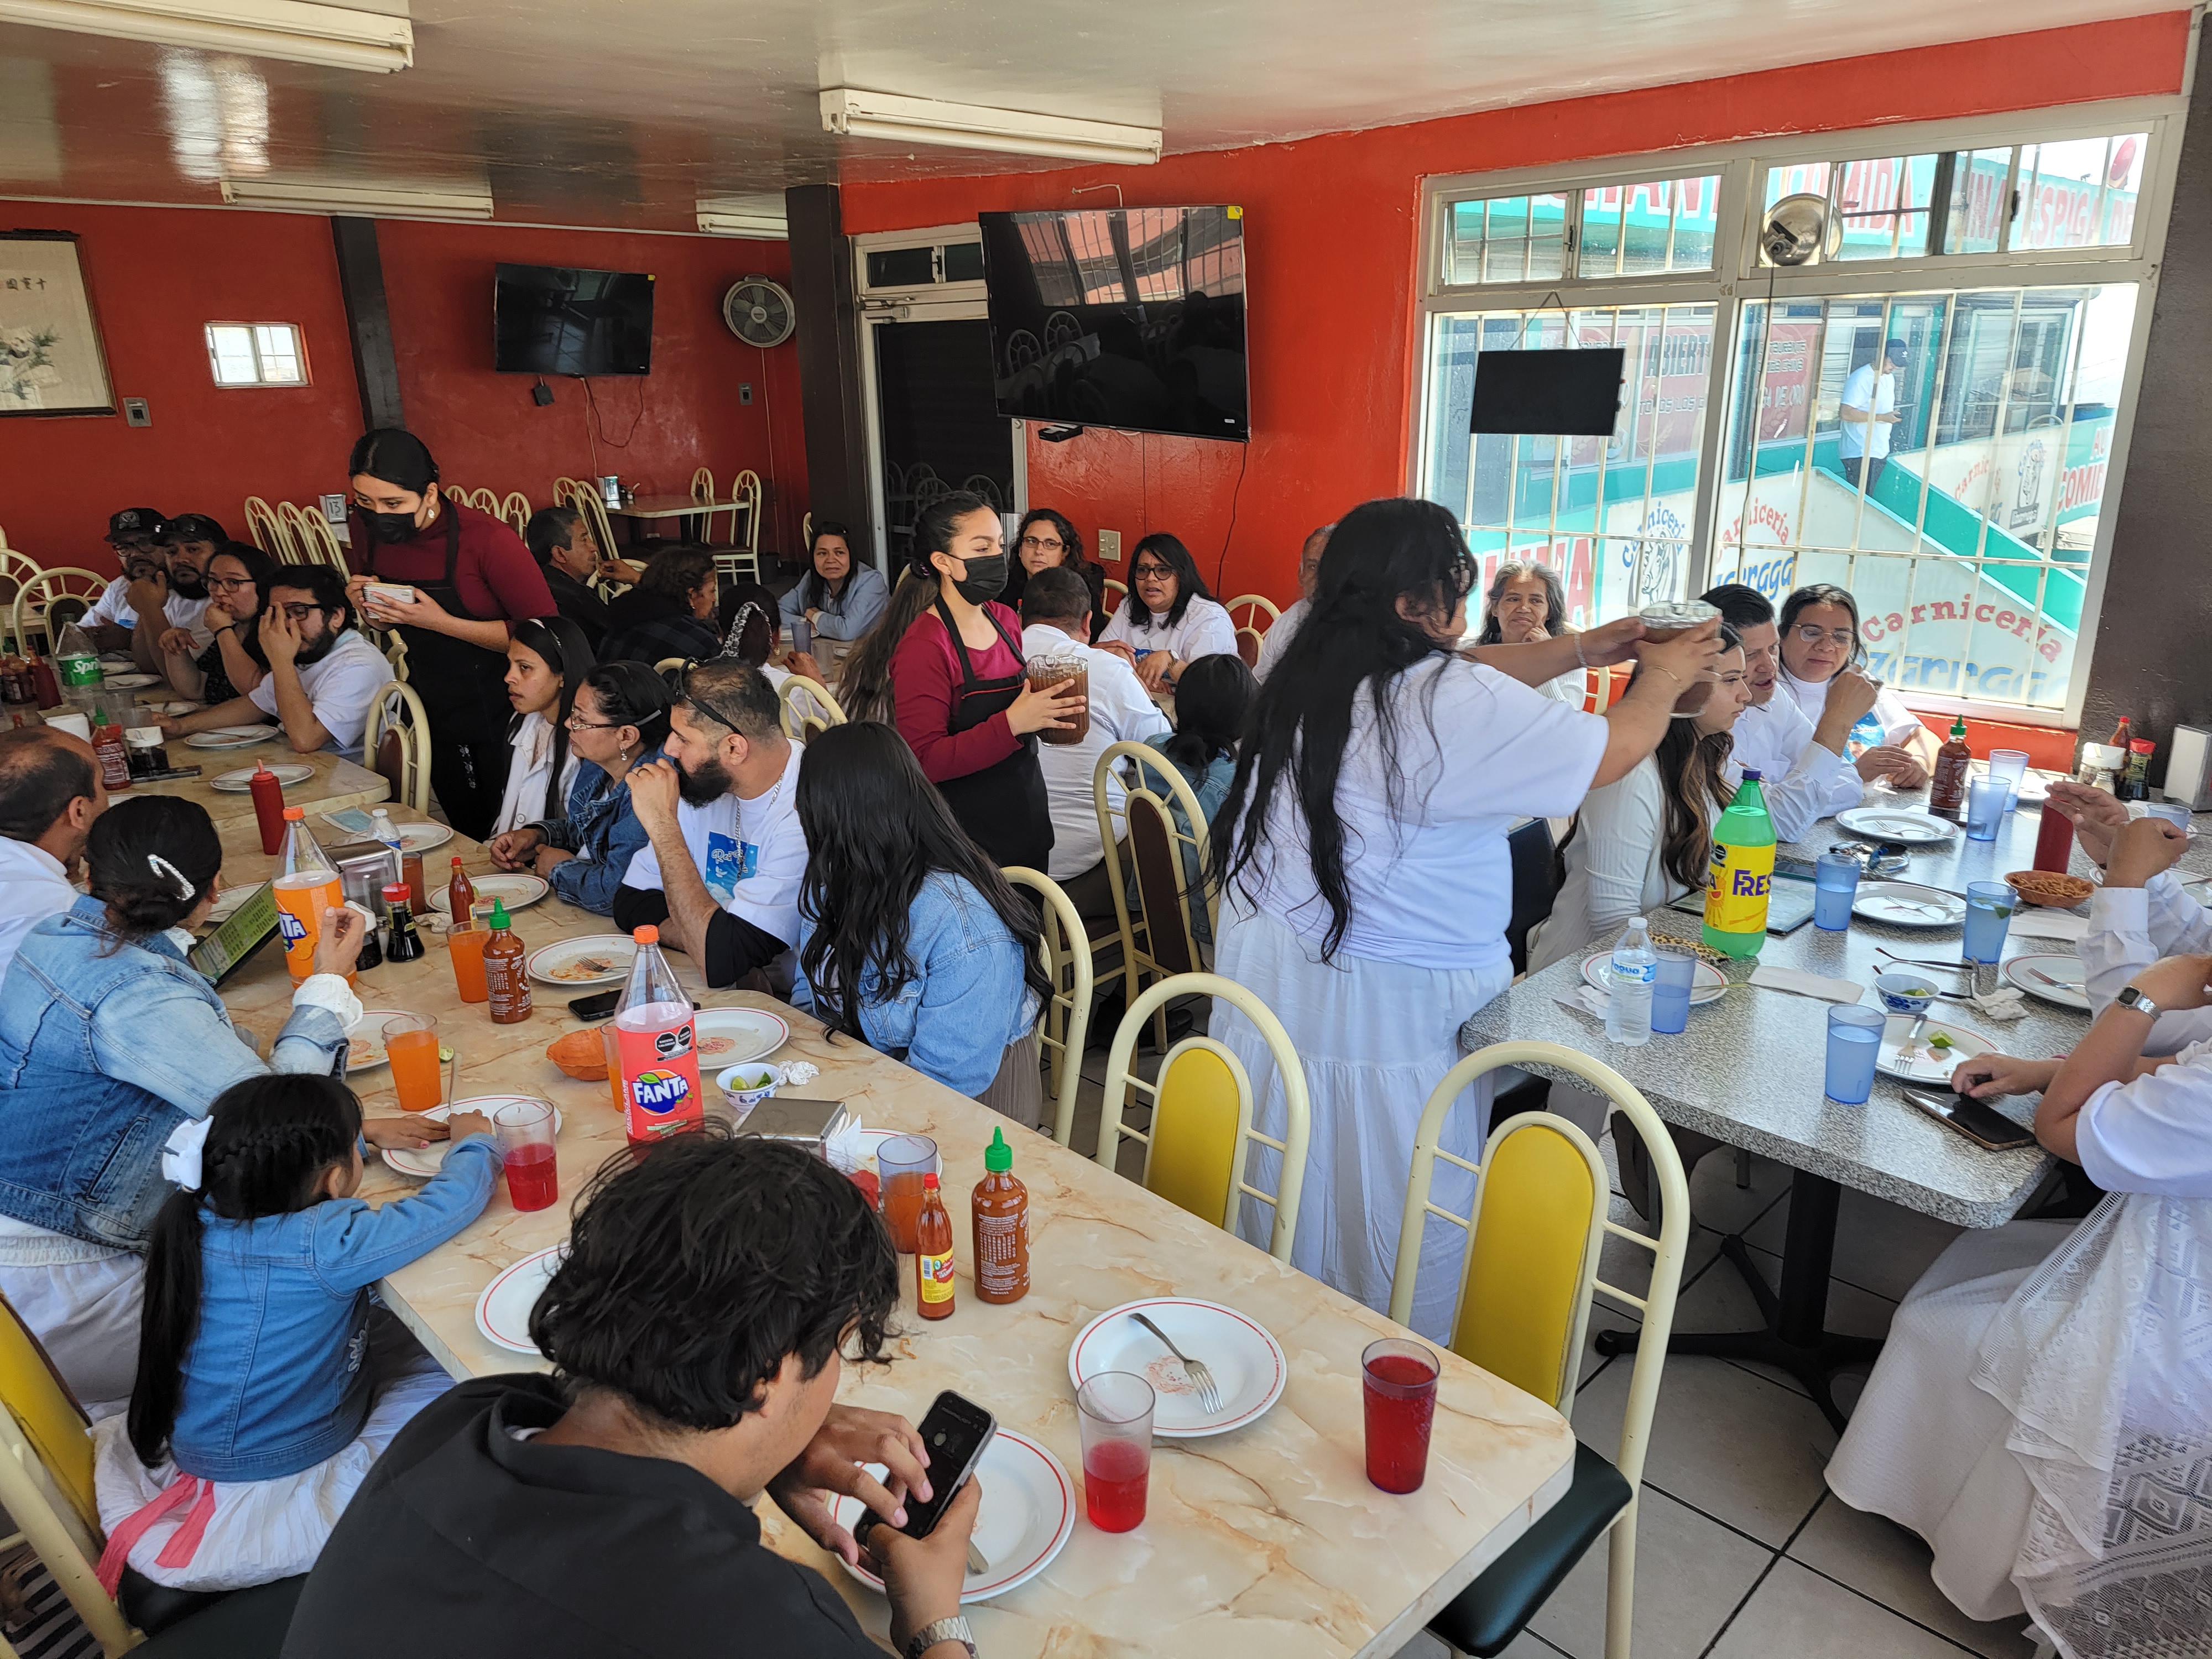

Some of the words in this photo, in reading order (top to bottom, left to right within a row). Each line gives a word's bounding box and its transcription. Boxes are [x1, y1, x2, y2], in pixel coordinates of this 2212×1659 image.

[1644, 334, 1711, 378] ABIERT
[330, 501, 341, 514] 13
[632, 1076, 689, 1104] FANTA
